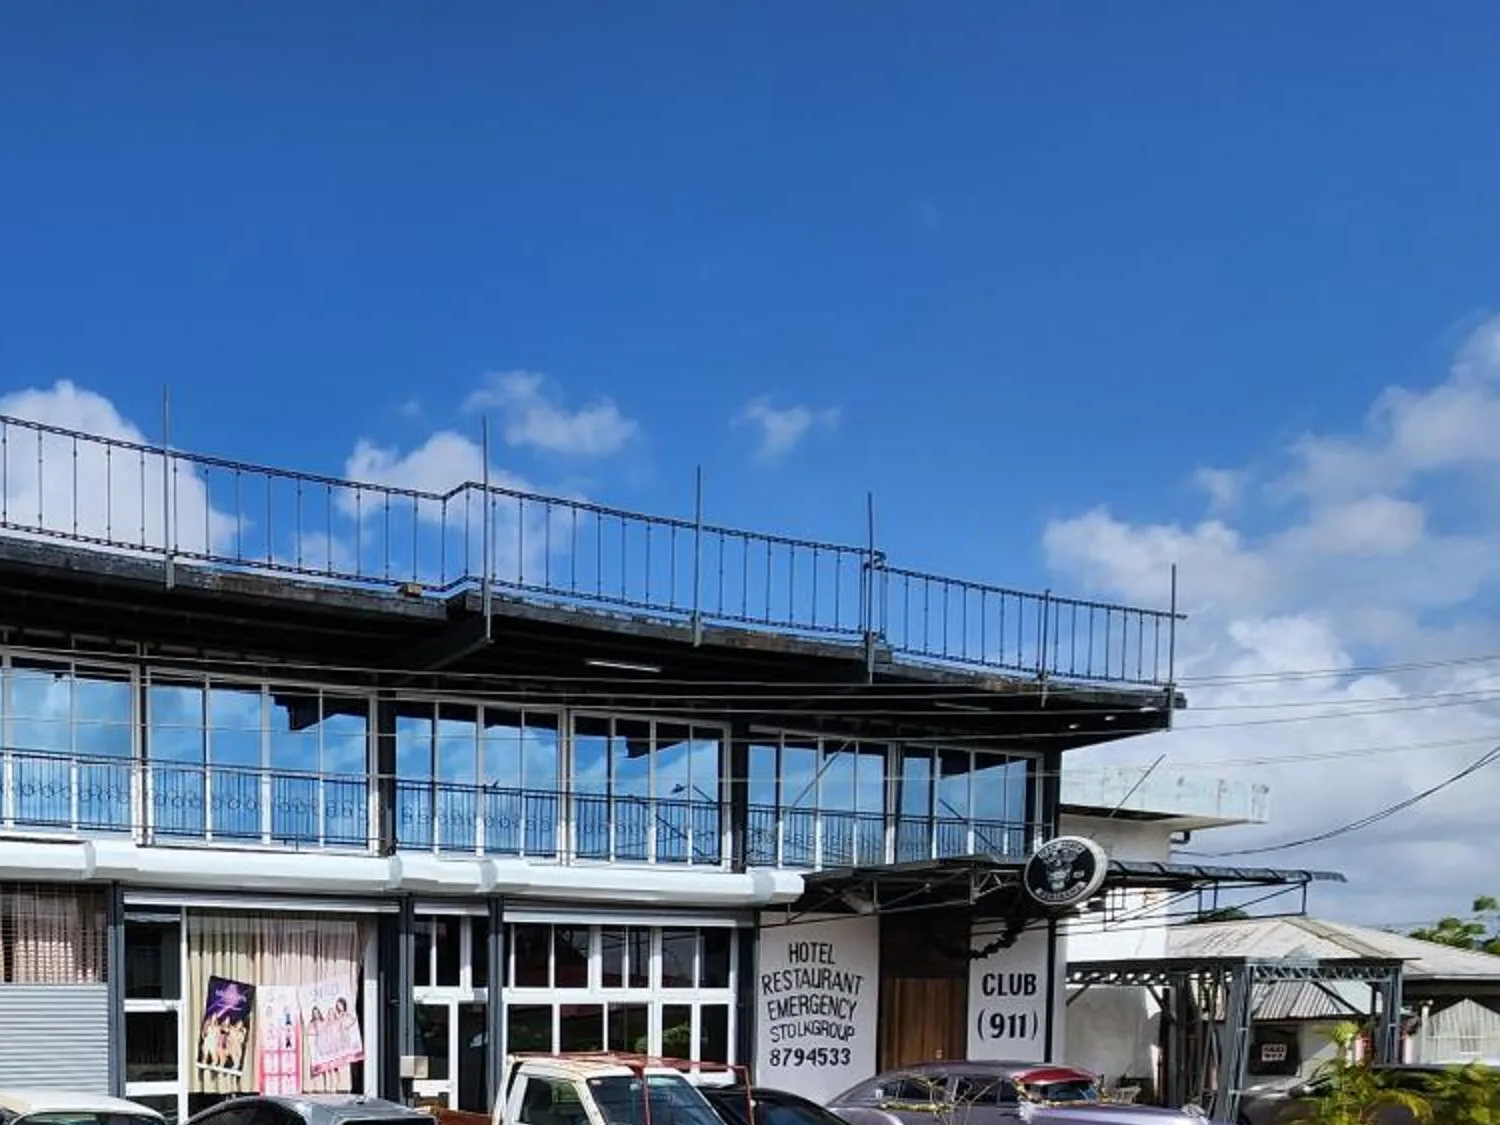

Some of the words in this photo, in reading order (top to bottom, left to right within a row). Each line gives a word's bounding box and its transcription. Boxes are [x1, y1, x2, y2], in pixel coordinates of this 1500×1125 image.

[788, 942, 836, 965] HOTEL
[761, 967, 864, 995] RESTAURANT
[982, 973, 1037, 996] CLUB
[767, 994, 857, 1021] EMERGENCY
[977, 1008, 1038, 1041] (911)
[769, 1047, 851, 1067] 8794533
